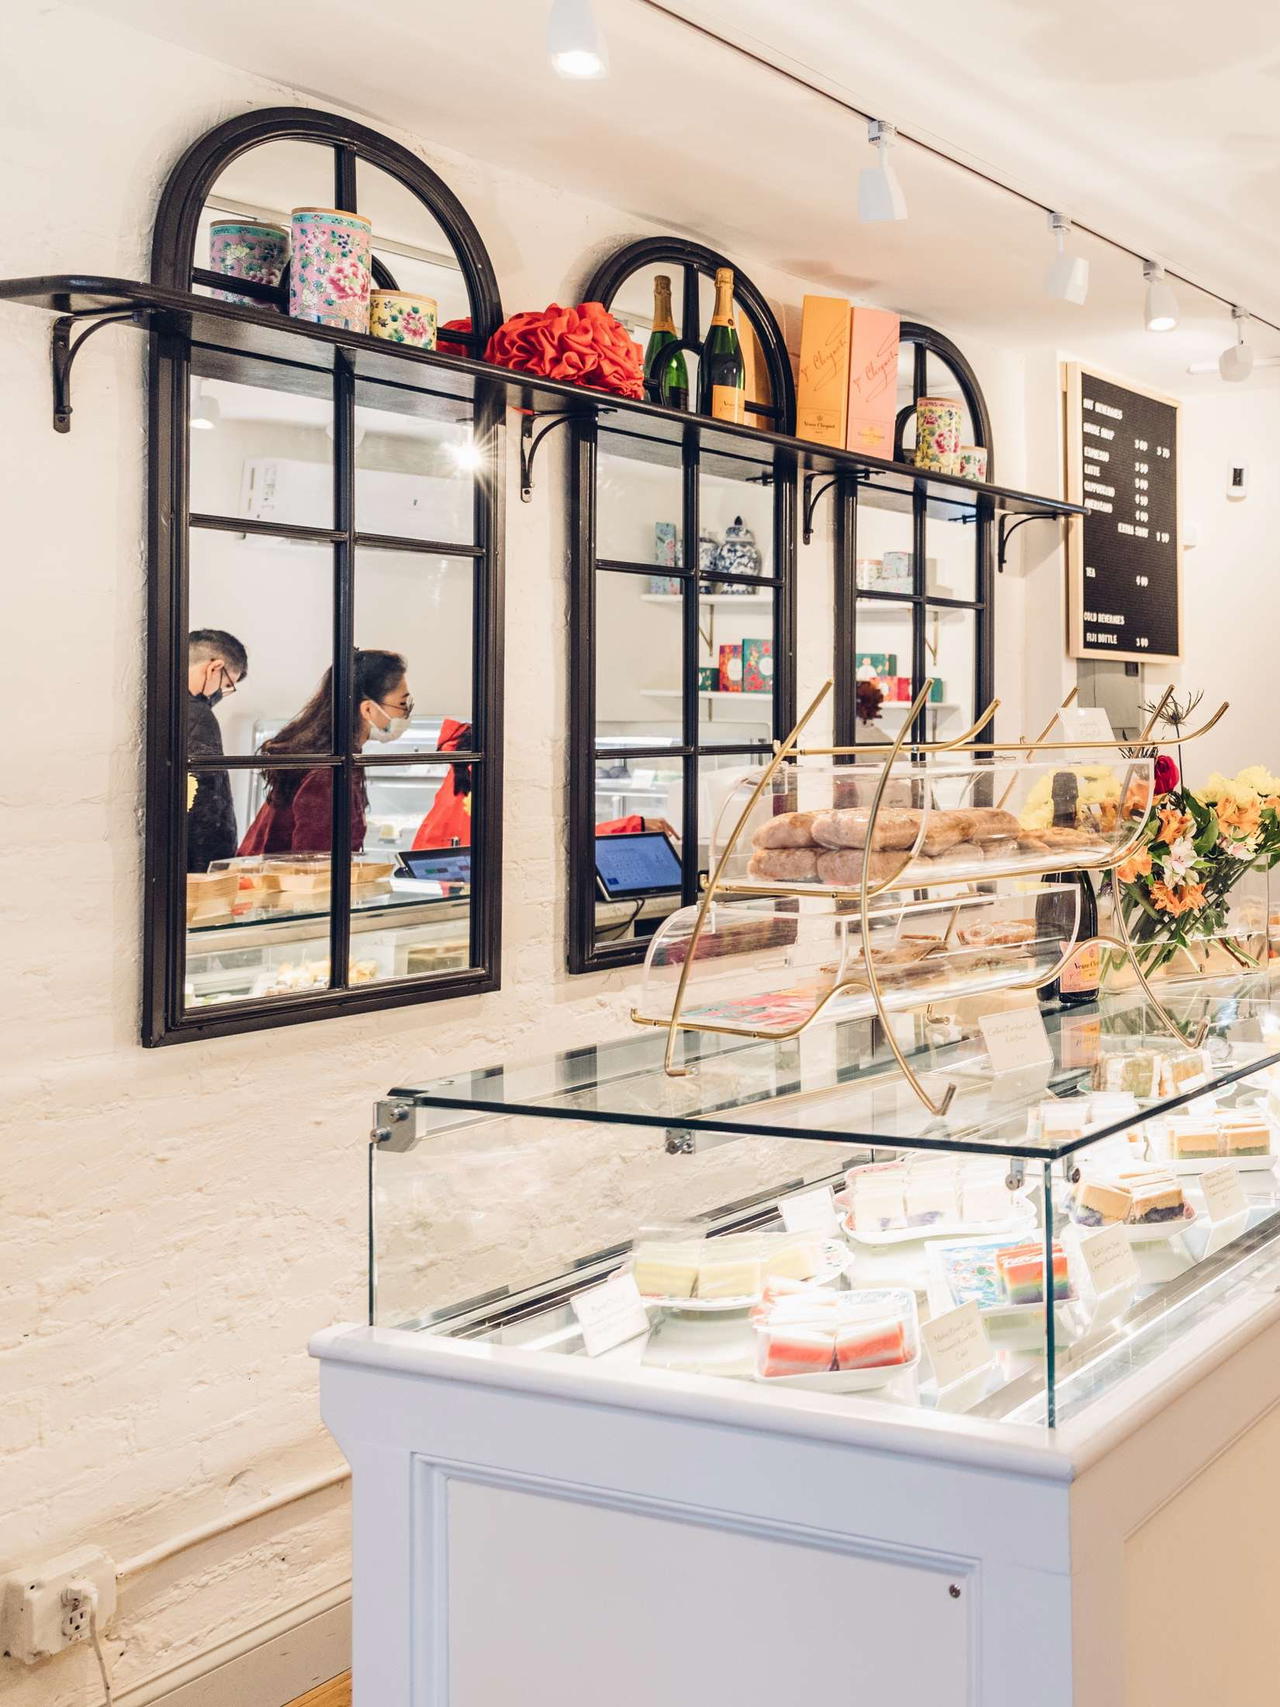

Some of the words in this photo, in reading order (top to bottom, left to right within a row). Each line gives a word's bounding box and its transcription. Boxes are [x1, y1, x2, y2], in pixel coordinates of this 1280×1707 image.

[1086, 567, 1096, 577] TEA
[1084, 612, 1097, 622] COLD
[1098, 613, 1125, 625] BEVERAGES
[1098, 633, 1118, 644] BOTTLE
